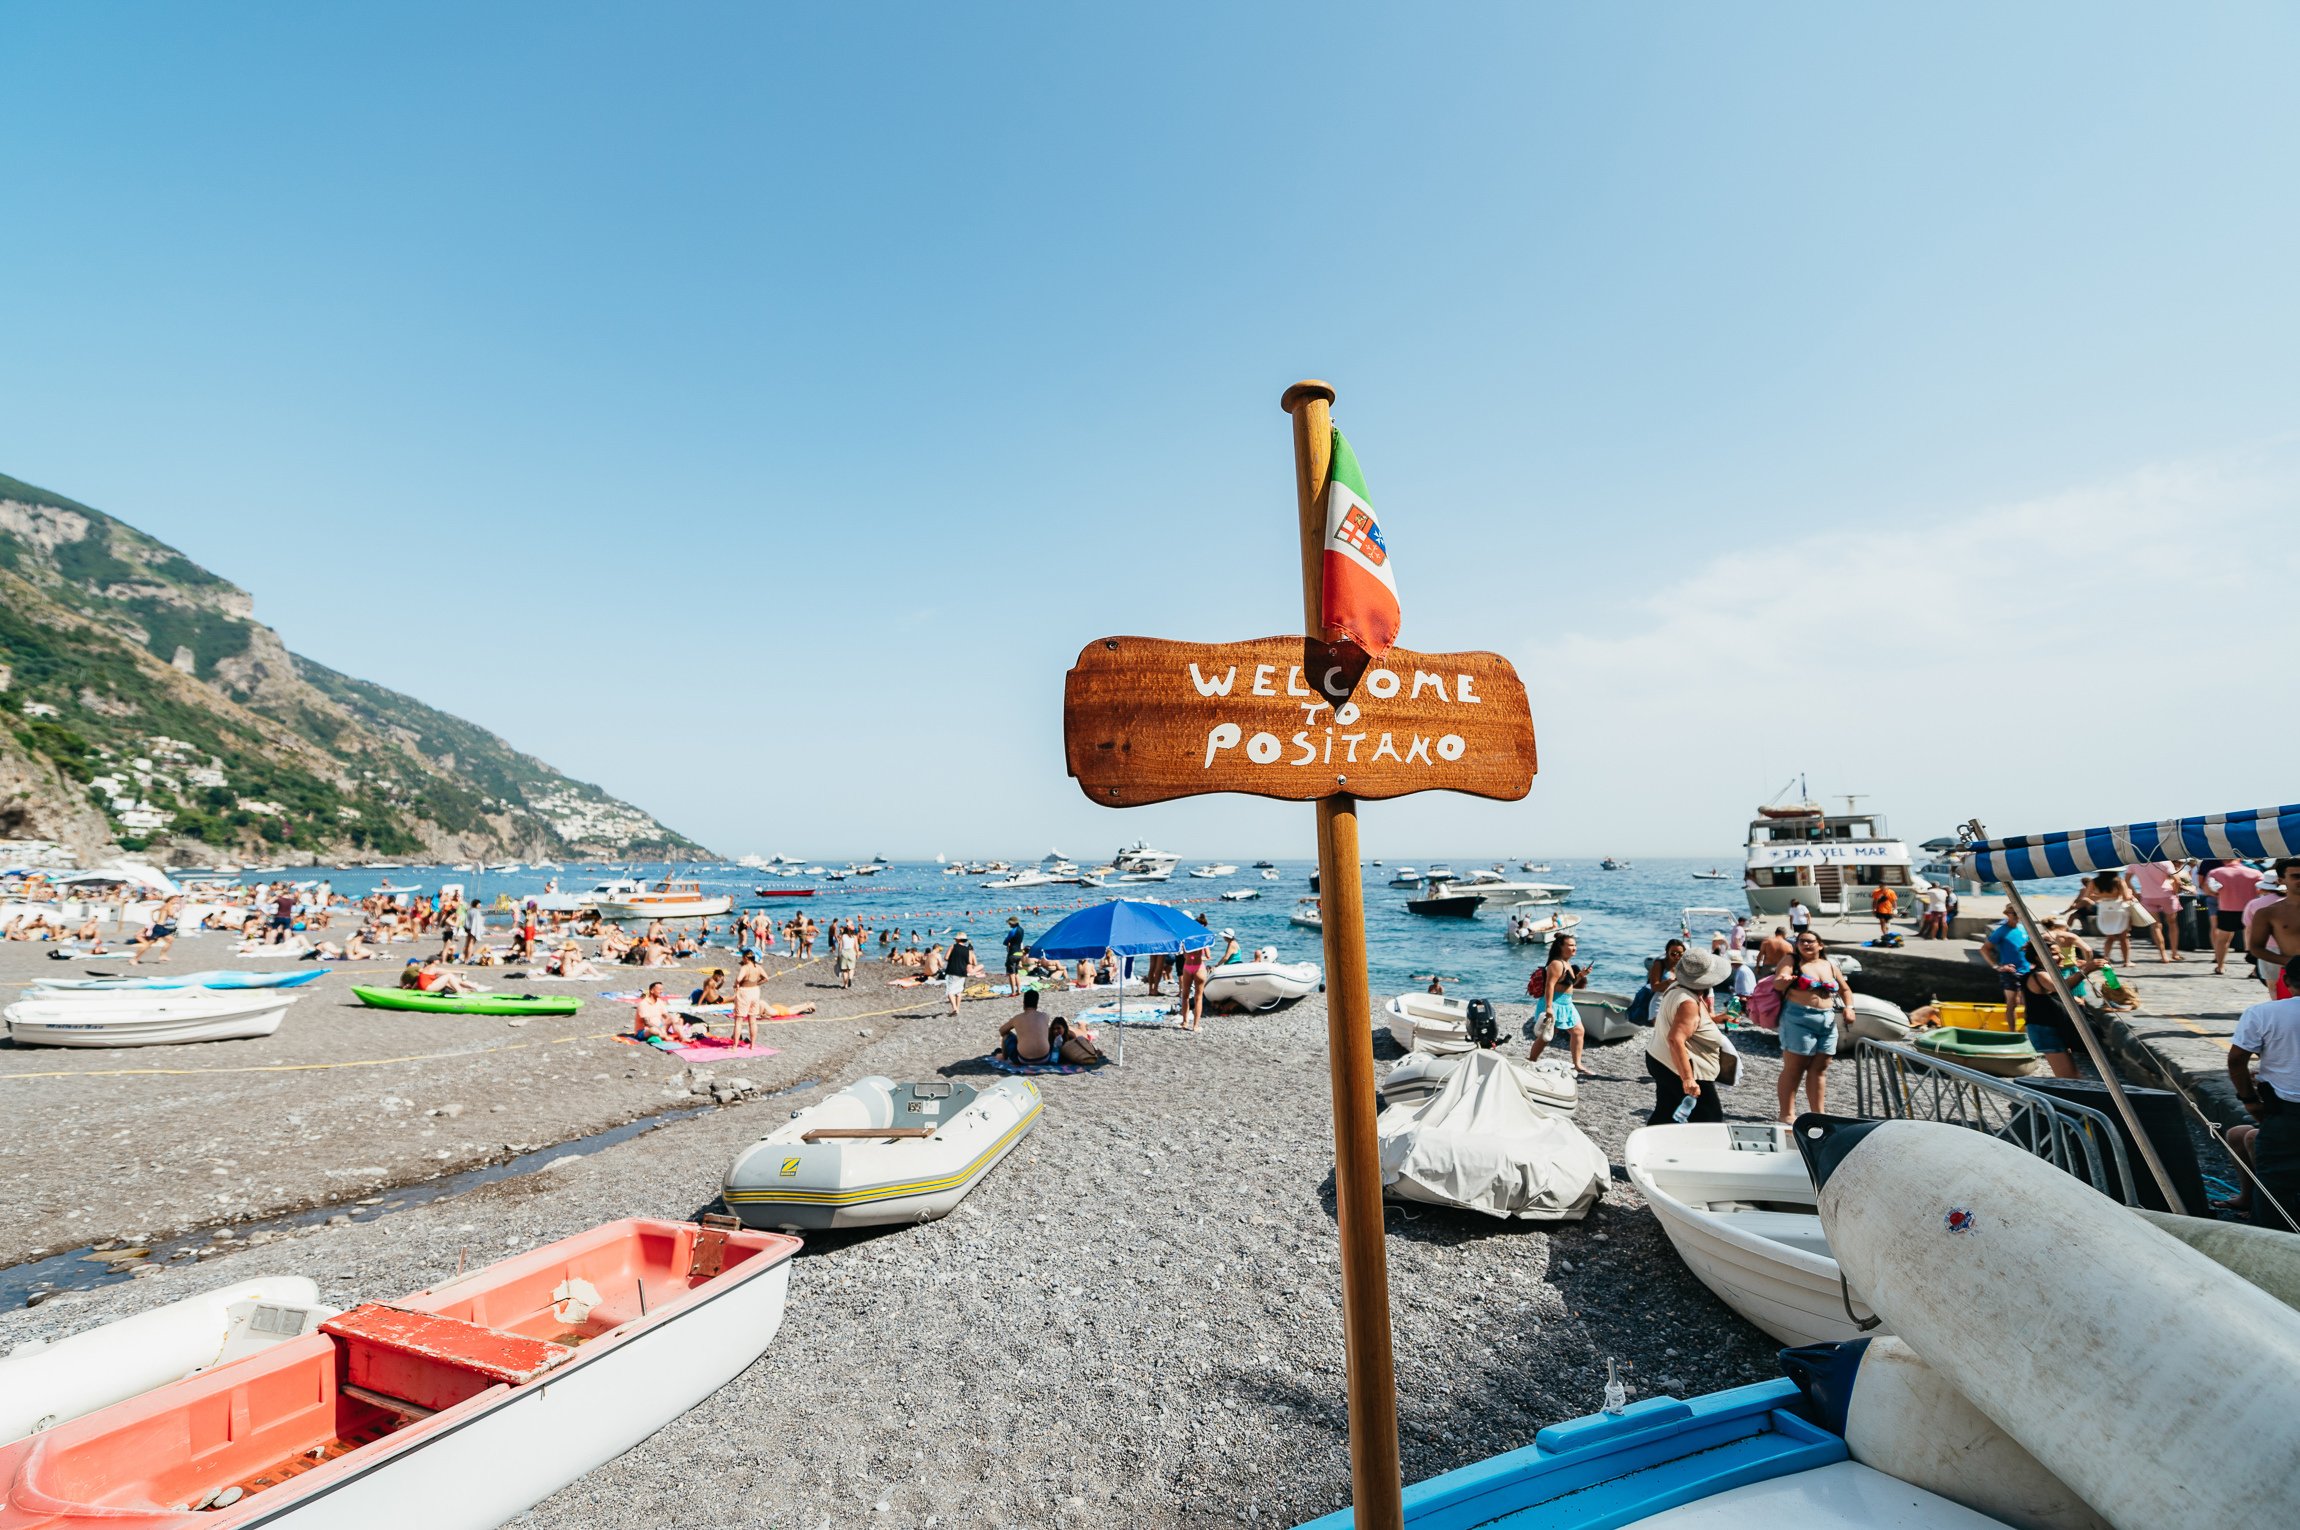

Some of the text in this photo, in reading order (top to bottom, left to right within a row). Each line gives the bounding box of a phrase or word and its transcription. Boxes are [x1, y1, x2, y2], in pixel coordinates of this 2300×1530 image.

[1188, 662, 1481, 703] WELCOME
[1300, 700, 1362, 726] TO
[1855, 846, 1888, 857] MAR
